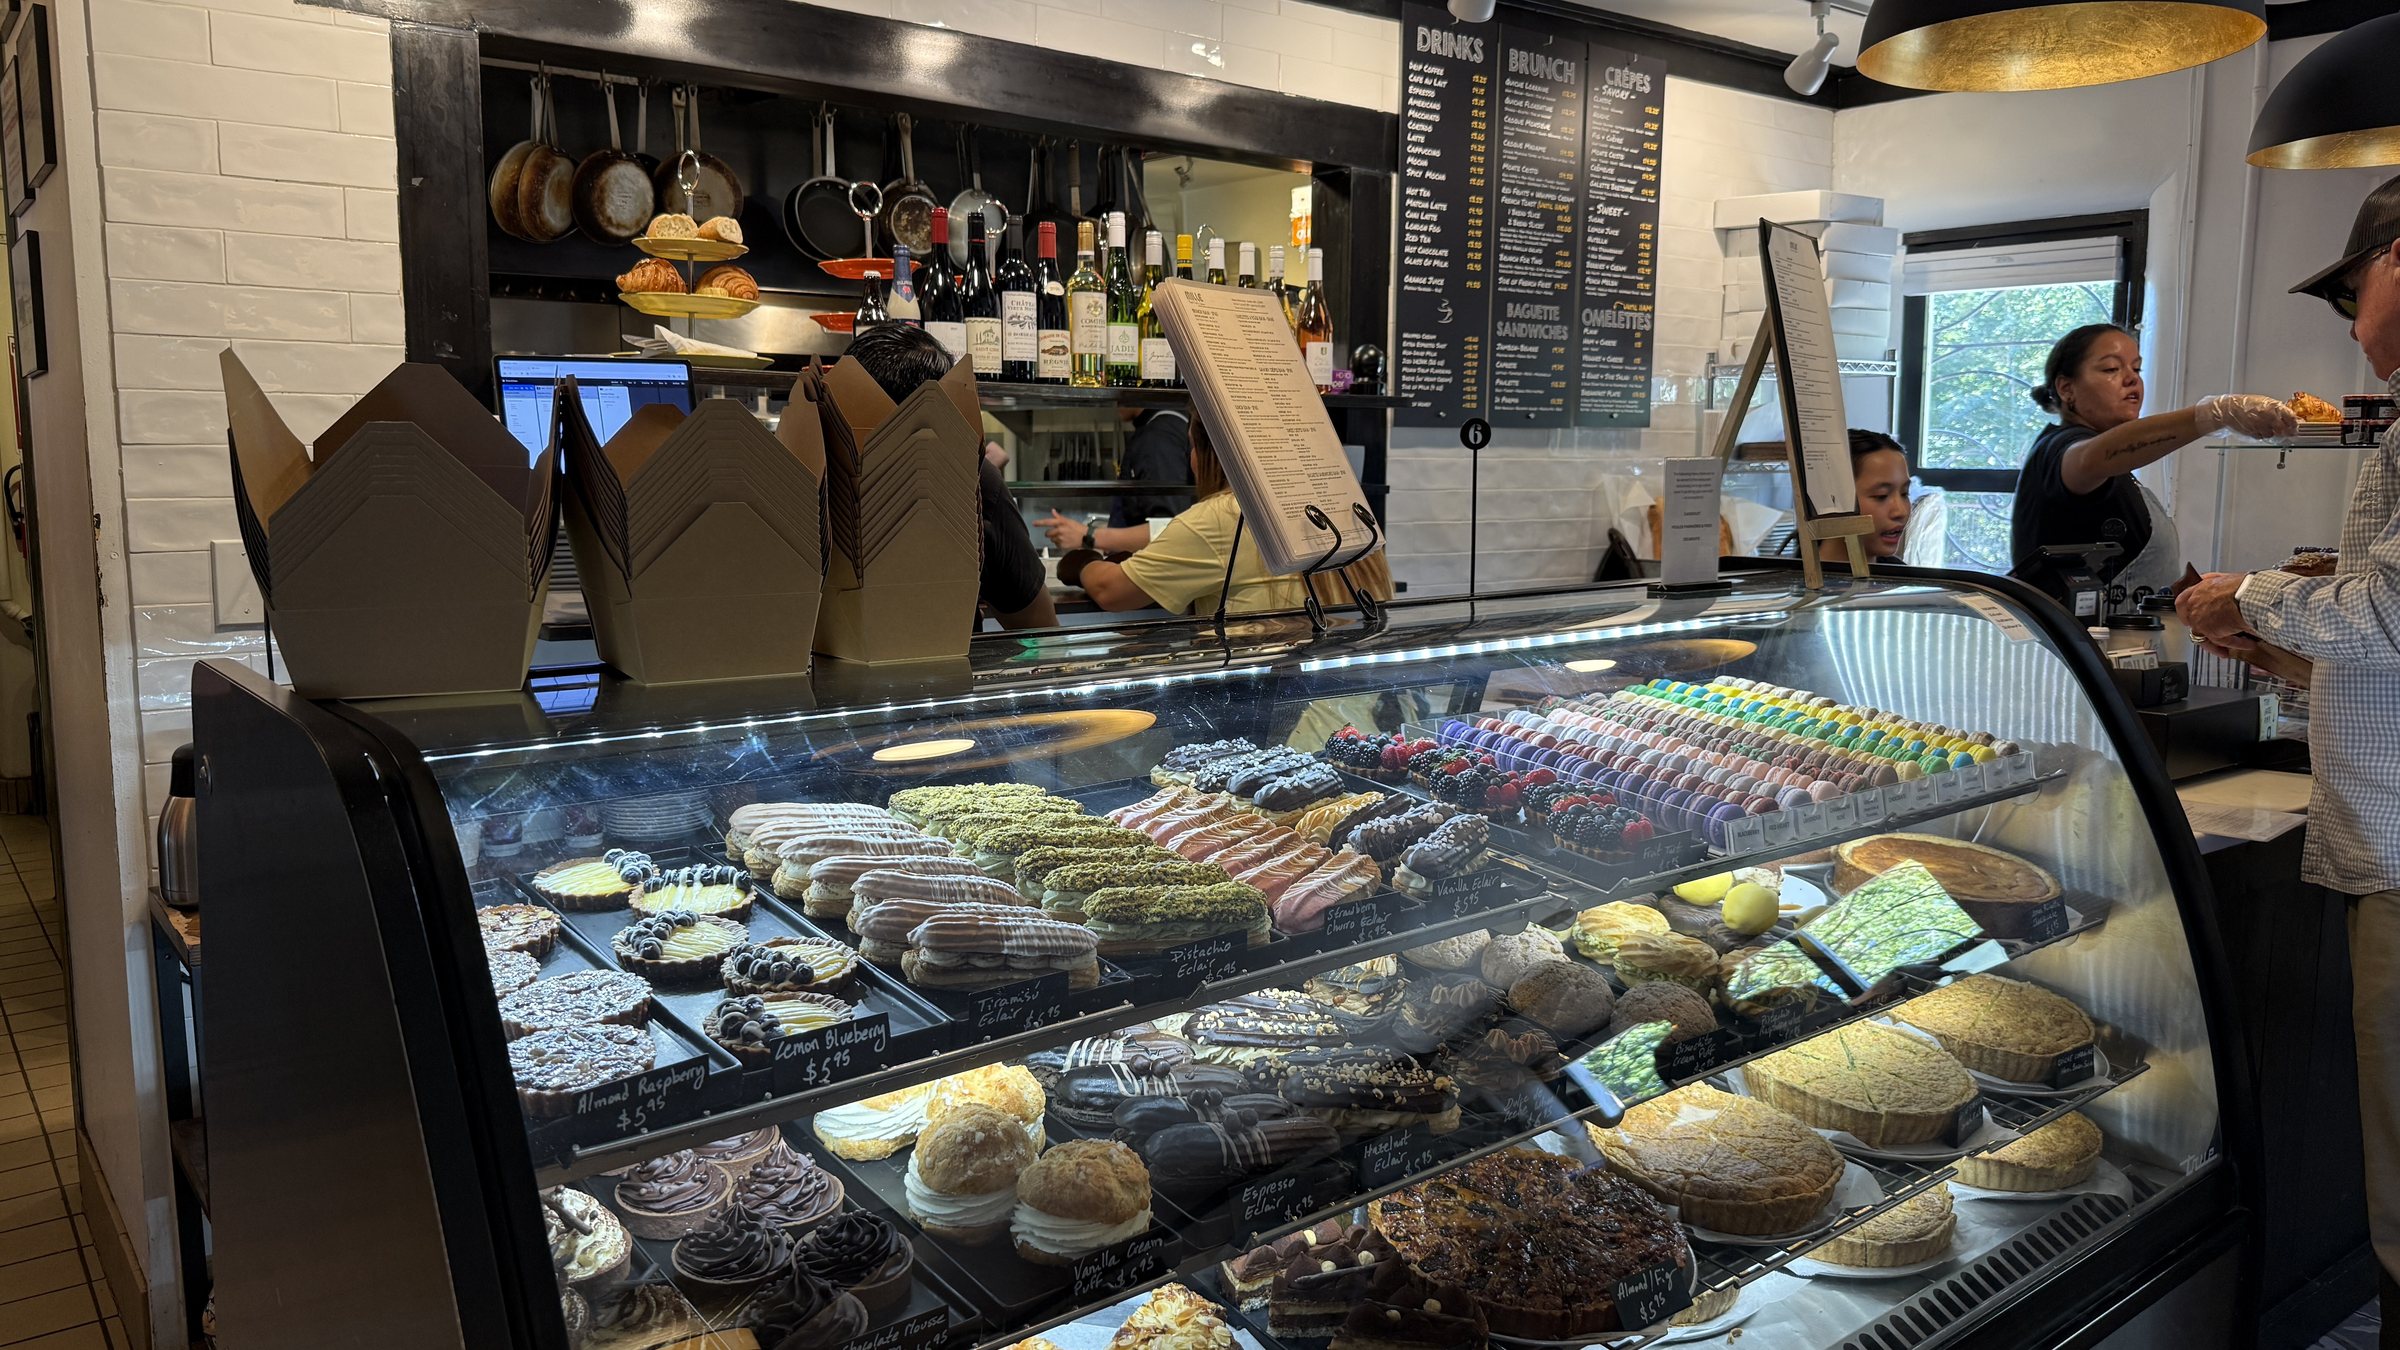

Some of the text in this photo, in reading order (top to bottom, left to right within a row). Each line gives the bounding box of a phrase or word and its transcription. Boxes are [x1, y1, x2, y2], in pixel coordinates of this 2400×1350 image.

[1416, 26, 1484, 64] DRINKS
[1423, 64, 1444, 76] COFFEE
[1508, 48, 1576, 85] BRUNCH
[1433, 78, 1448, 88] LAIT
[1504, 78, 1524, 89] QUICHE
[1408, 86, 1436, 98] ESPRESSO
[1602, 85, 1630, 100] SAVORY
[1408, 97, 1441, 110] AMERICANO
[1504, 96, 1554, 112] QUICHE FLORENTINE
[1407, 121, 1434, 132] CORTADO
[1406, 132, 1425, 143] LATTE
[1406, 145, 1441, 157] CAPPUCCINO
[1524, 143, 1547, 153] MADAME
[1591, 148, 1608, 157] MONTE
[1406, 156, 1428, 167] MOCHA
[1502, 162, 1520, 172] MONTE
[1406, 167, 1446, 181] SPICY MOCHA
[1589, 180, 1610, 189] GALETTE
[1406, 187, 1432, 198] HOT TEA
[1501, 186, 1511, 194] RED
[1512, 187, 1529, 196] FRUITS
[1558, 194, 1575, 202] CREAM
[1405, 198, 1448, 211] MATCHA LATTE
[1501, 196, 1537, 207] FRENCH TOAST
[1405, 210, 1438, 221] CHAI LATTE
[1527, 211, 1541, 219] SLICE
[1597, 203, 1624, 217] SWEET
[1405, 221, 1441, 233] LONDON FOG
[1587, 225, 1620, 236] LEMON JUICE
[1405, 233, 1432, 244] ICED TEA
[1404, 245, 1417, 254] HOT
[1418, 247, 1449, 257] CHOCOLATE
[1404, 257, 1449, 268] GLASS OF MILK
[1520, 256, 1530, 264] FOR
[1530, 257, 1543, 265] TWO
[1610, 264, 1628, 272] CREAM
[1404, 274, 1445, 286] ORANGE JUICE
[1506, 303, 1560, 320] BAGUETTE
[1581, 308, 1652, 331] OMELETTES
[1496, 321, 1568, 340] SANDWICHES
[1468, 424, 1483, 445] 6
[1437, 873, 1499, 896] Vanilla Eclair
[1328, 902, 1376, 920] Strawberry
[1326, 912, 1392, 935] Churro Eclair
[1170, 940, 1231, 962] Pistachio
[1177, 959, 1216, 978] Eclair
[978, 1007, 1022, 1028] Eclair
[774, 1022, 886, 1060] Lemon Blueberry
[577, 1064, 706, 1115] Almond Raspberry
[1364, 1129, 1412, 1159] Hazelnut
[1373, 1151, 1408, 1173] Eclair
[1242, 1177, 1296, 1208] Espresso
[1244, 1194, 1284, 1221] Eclair
[1074, 1238, 1163, 1280] Vanilla Cream
[1073, 1272, 1103, 1296] Puff
[904, 1314, 946, 1337] Mousse
